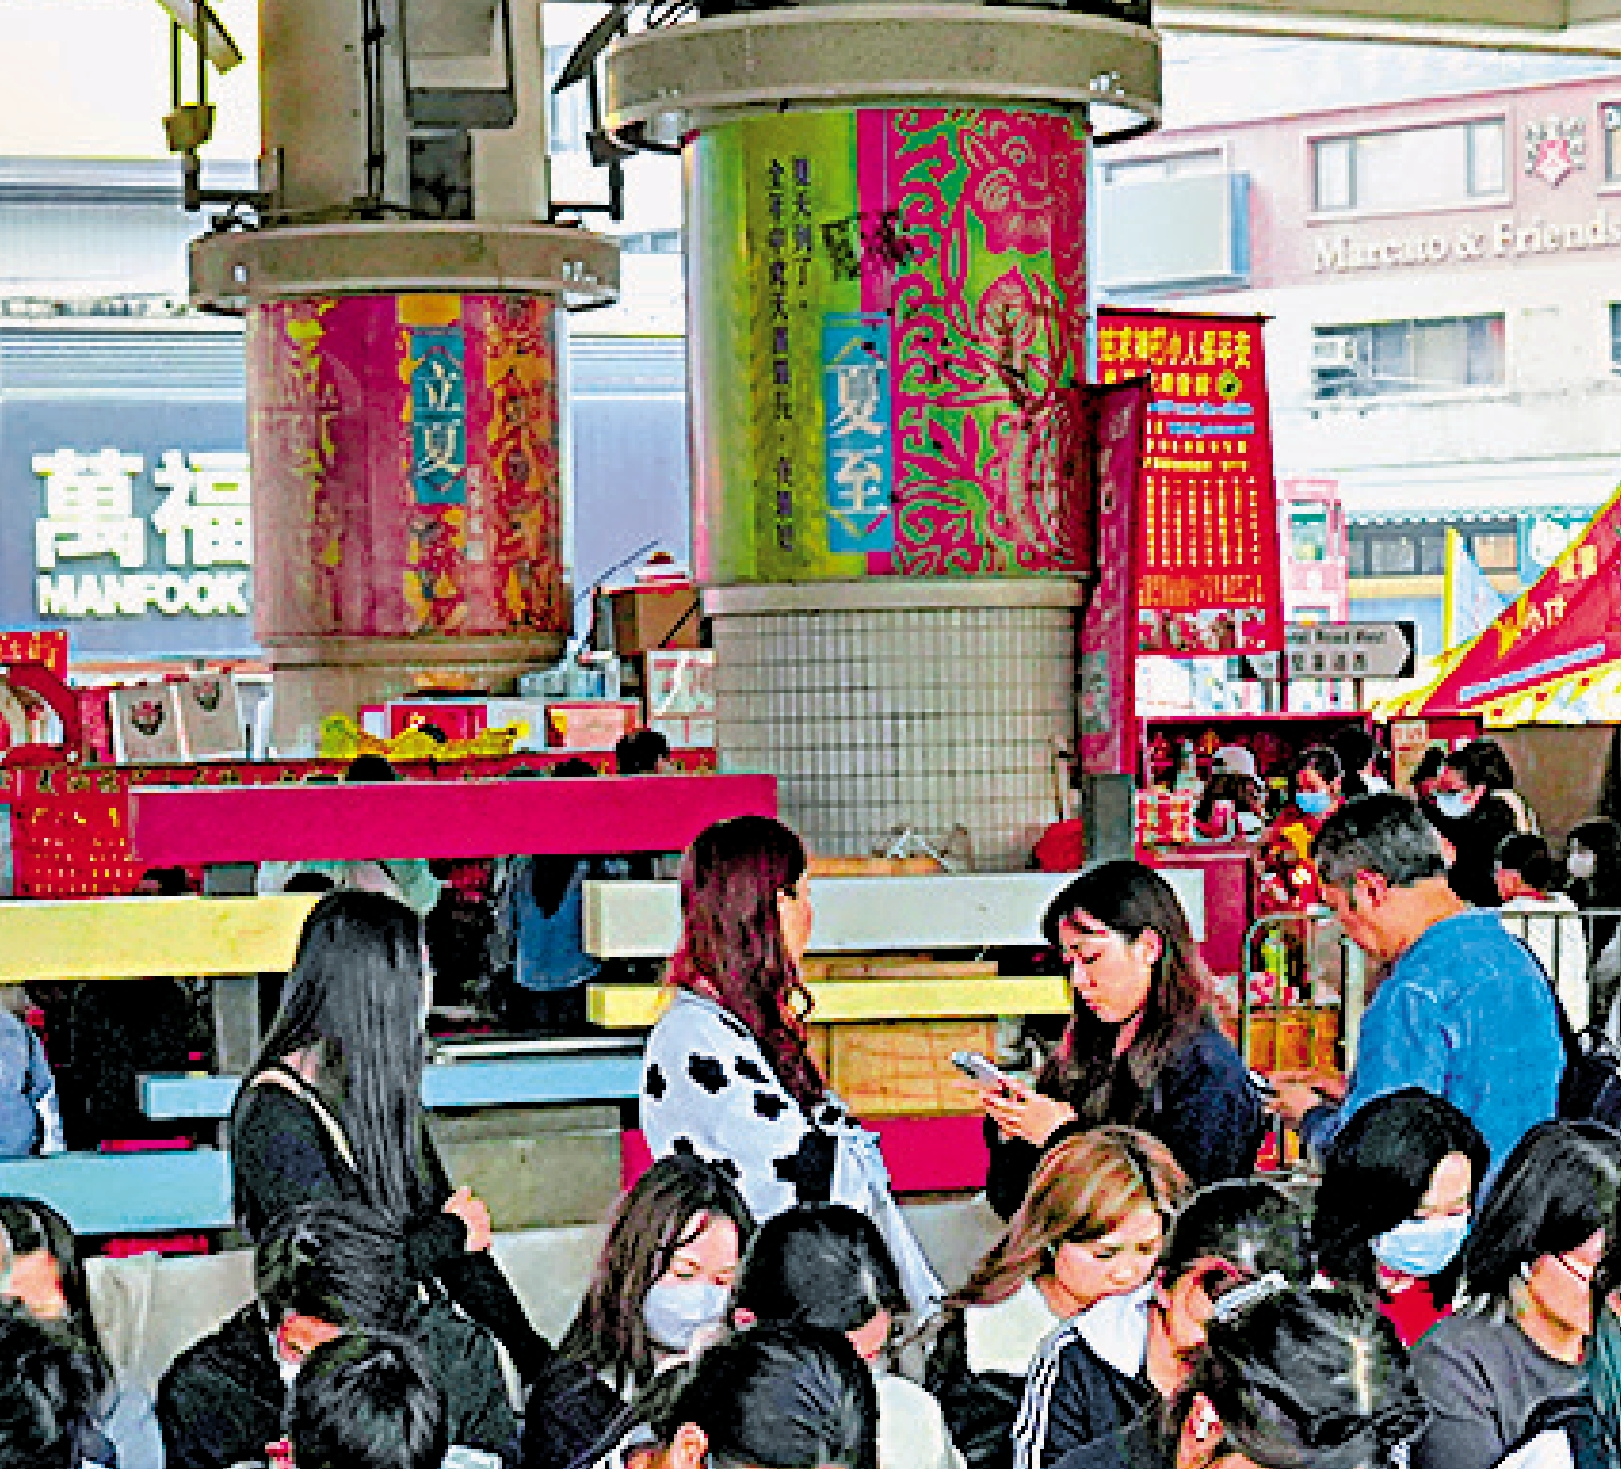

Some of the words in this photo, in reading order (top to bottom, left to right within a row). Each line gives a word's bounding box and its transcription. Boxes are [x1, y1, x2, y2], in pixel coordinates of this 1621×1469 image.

[413, 358, 463, 482] 立夏
[827, 362, 889, 518] 夏至
[31, 447, 253, 570] 萬福
[36, 572, 251, 617] MANFOOK
